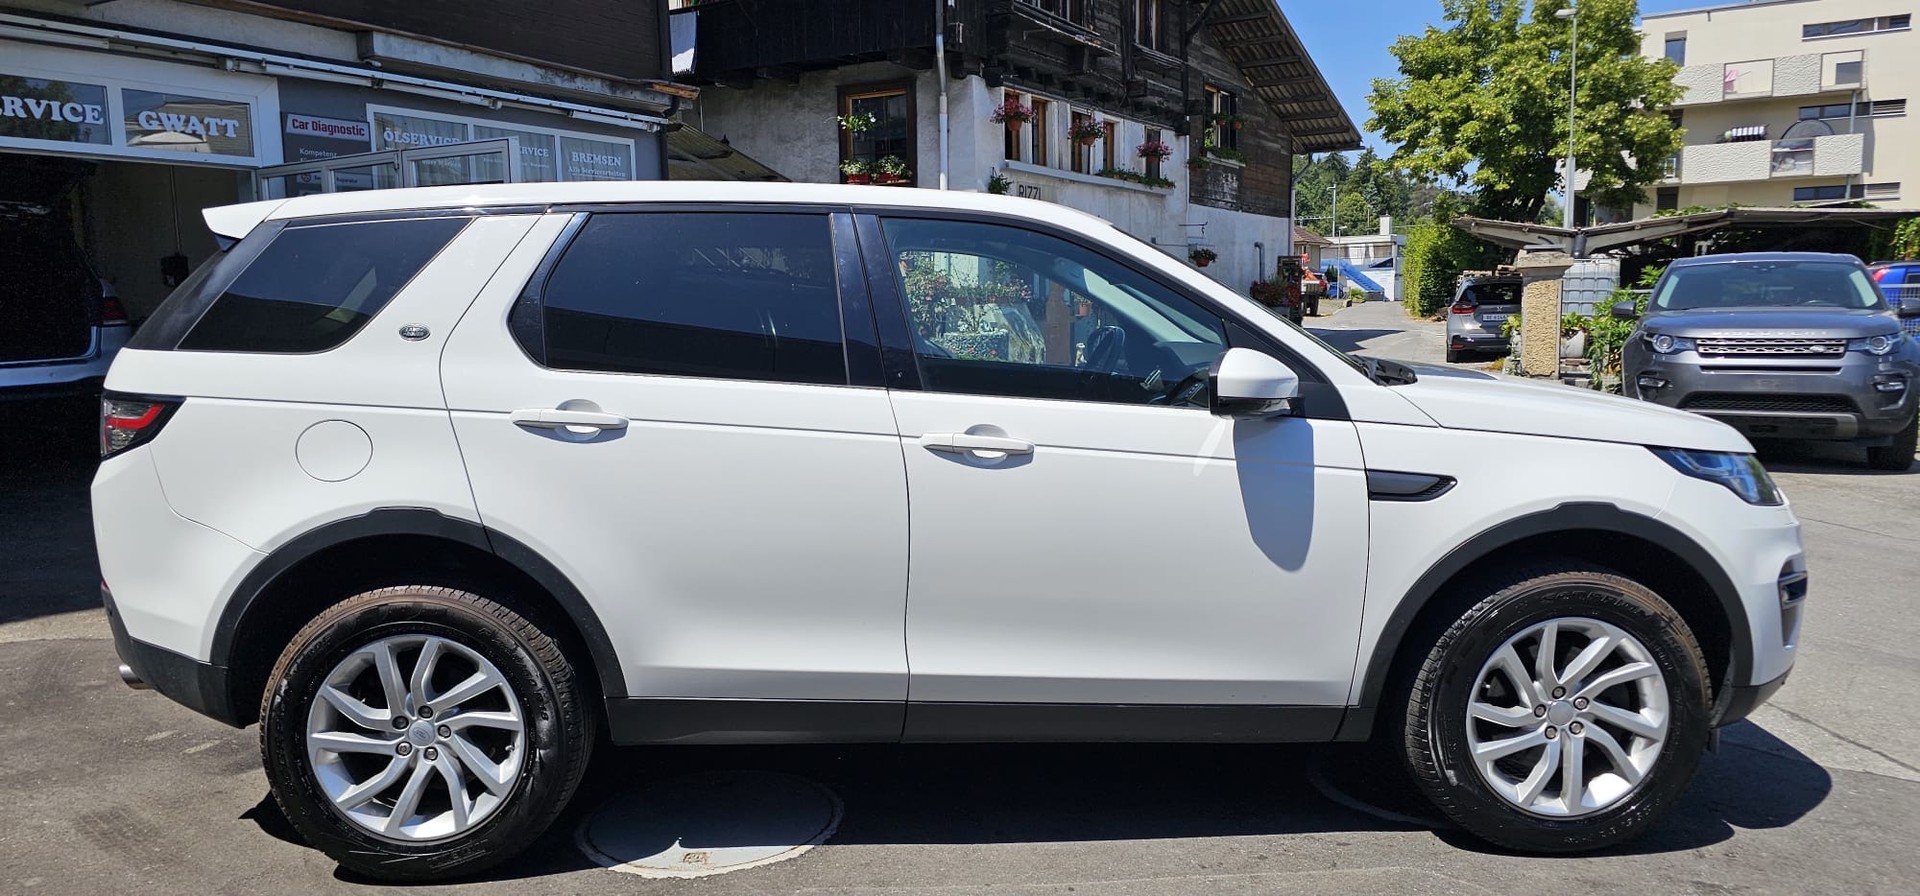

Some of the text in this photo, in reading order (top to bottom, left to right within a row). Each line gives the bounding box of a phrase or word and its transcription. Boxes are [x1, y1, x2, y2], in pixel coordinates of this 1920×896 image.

[0, 96, 103, 125] RVICE
[138, 110, 239, 139] GWATT
[292, 119, 365, 136] Car Diagnostic
[383, 127, 460, 146] ÖLSERVI
[571, 151, 622, 167] BREMSEN
[1019, 185, 1041, 200] RIZZI
